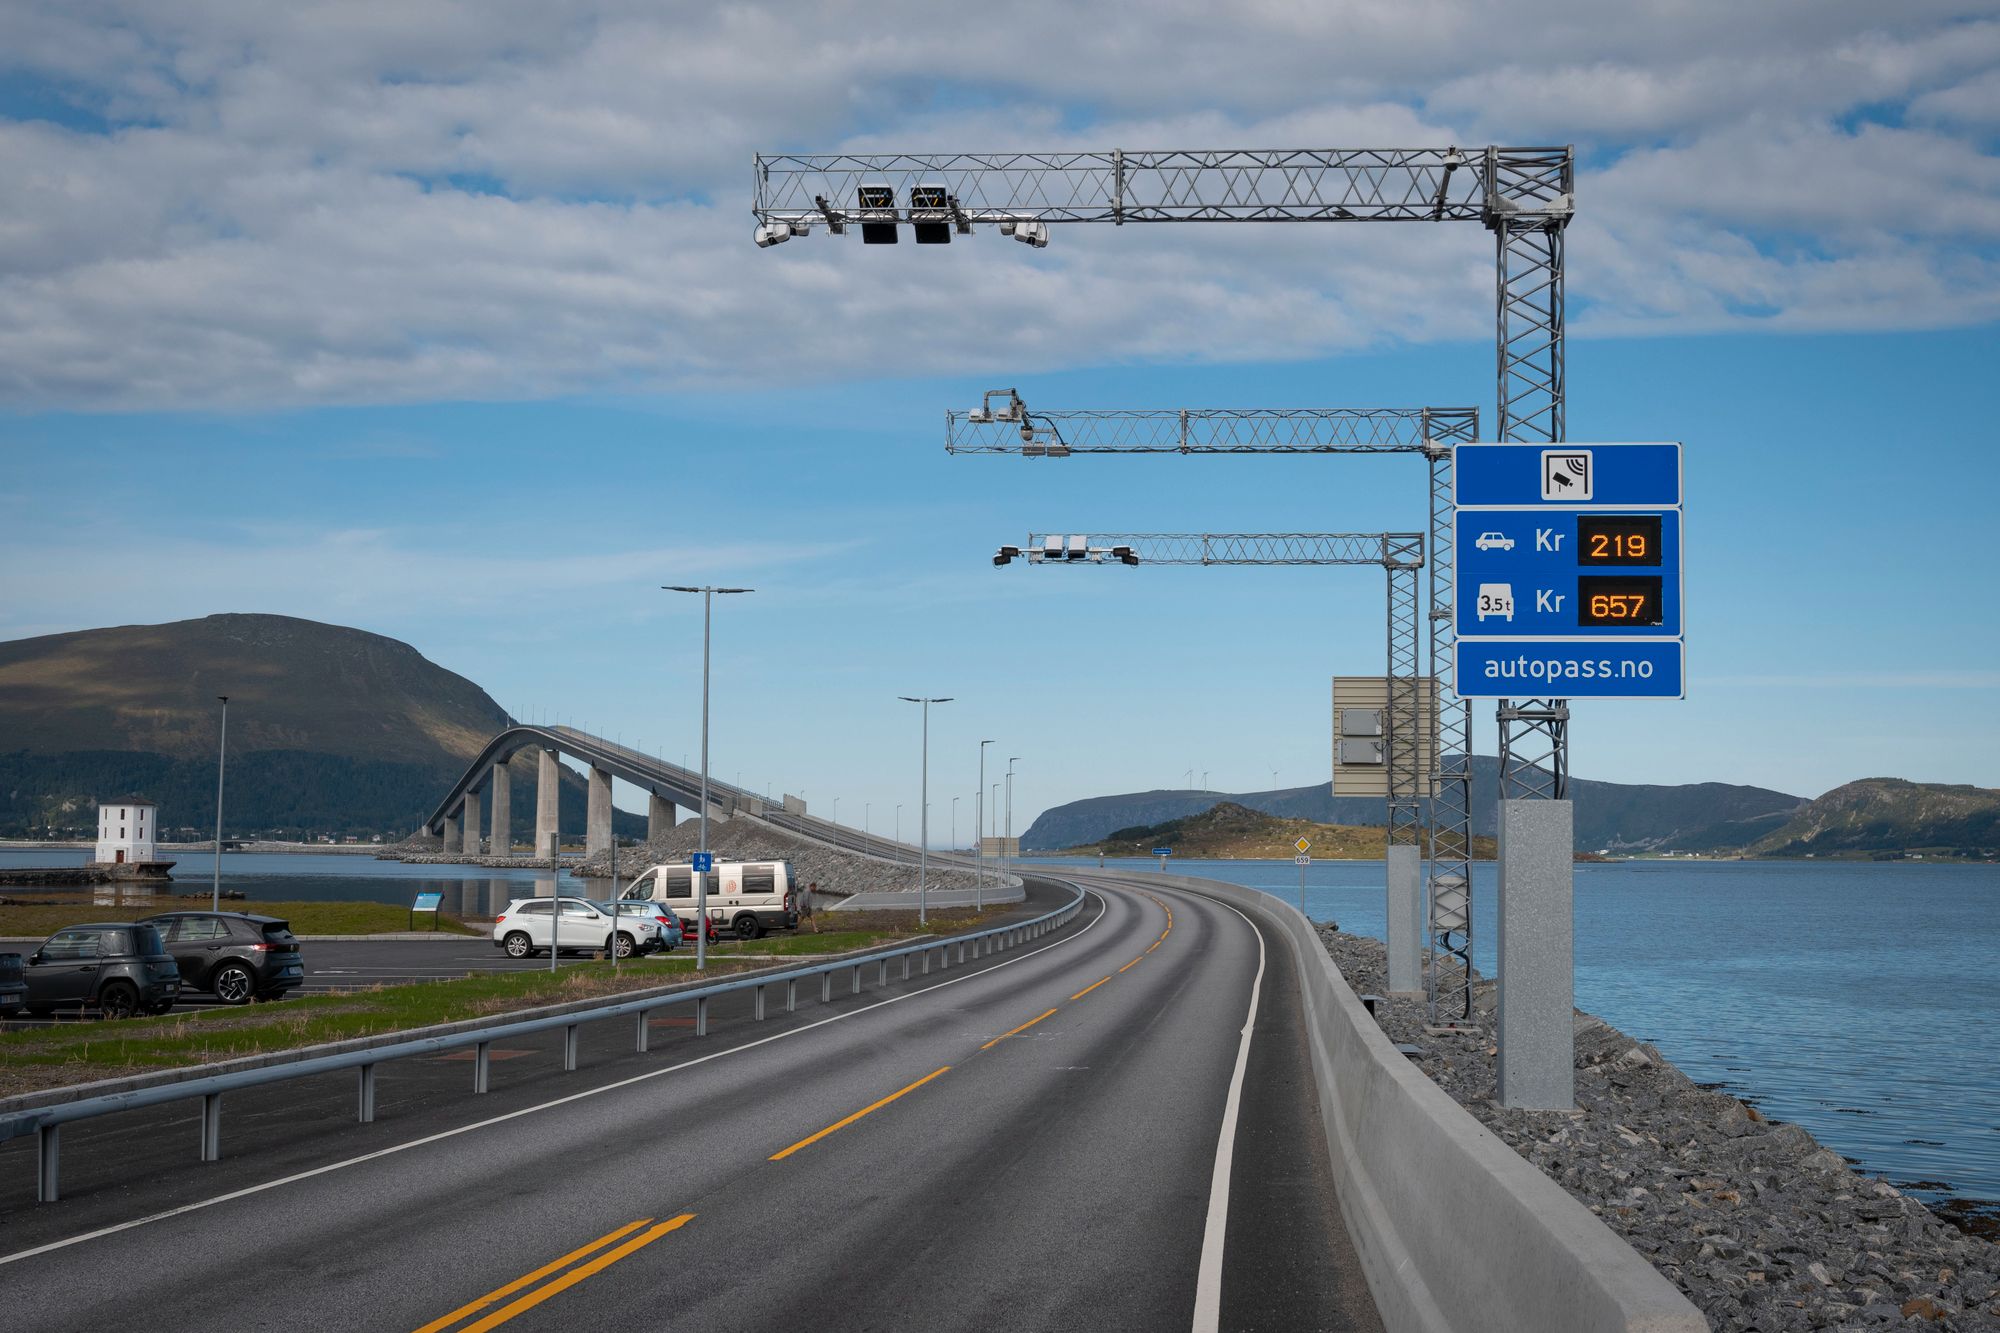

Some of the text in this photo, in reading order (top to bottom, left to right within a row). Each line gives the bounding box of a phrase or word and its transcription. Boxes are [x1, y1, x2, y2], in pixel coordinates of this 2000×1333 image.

[1536, 528, 1565, 552] Kr
[1591, 534, 1645, 557] 219
[1536, 589, 1565, 613] Kr
[1591, 595, 1645, 618] 657
[1484, 654, 1654, 684] autopass.no
